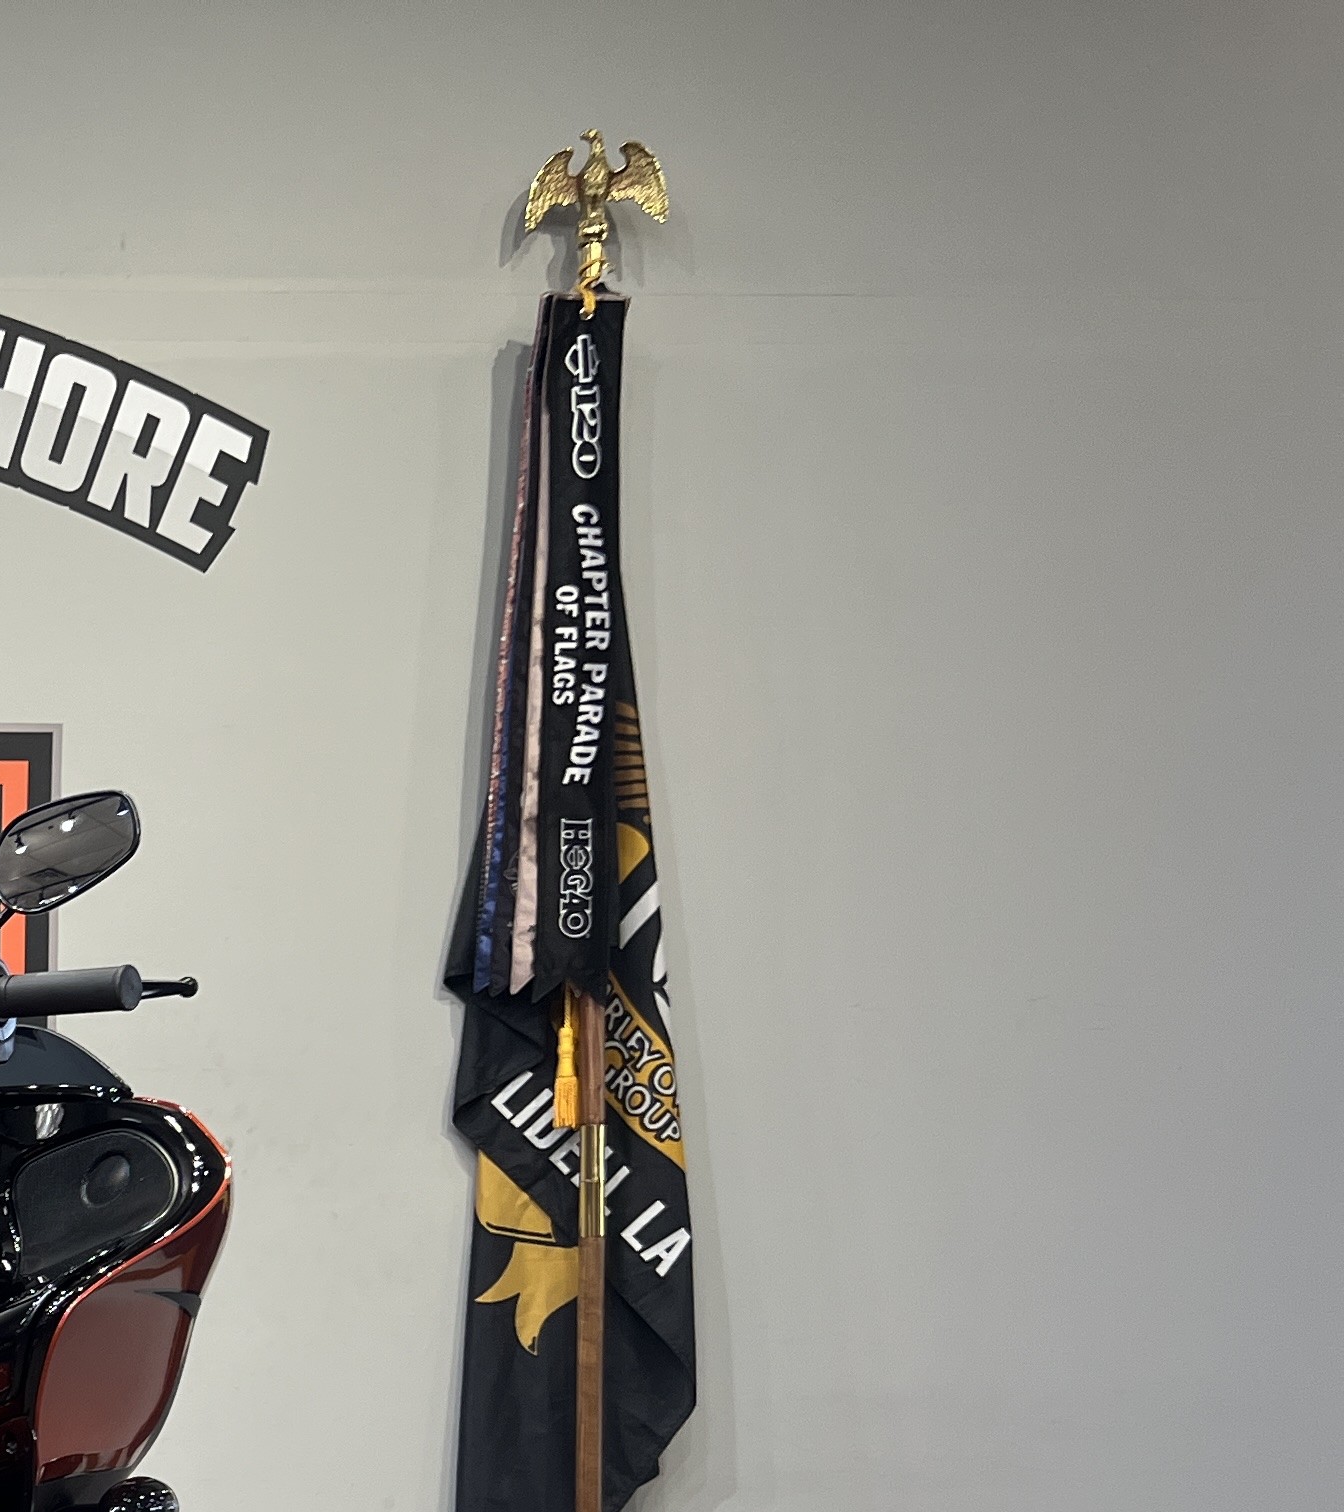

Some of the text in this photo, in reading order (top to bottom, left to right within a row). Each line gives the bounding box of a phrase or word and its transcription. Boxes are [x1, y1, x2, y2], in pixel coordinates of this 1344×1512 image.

[552, 584, 579, 706] OF FLAGS
[562, 503, 611, 786] CHAPTER PARADE
[620, 1200, 691, 1278] LA
